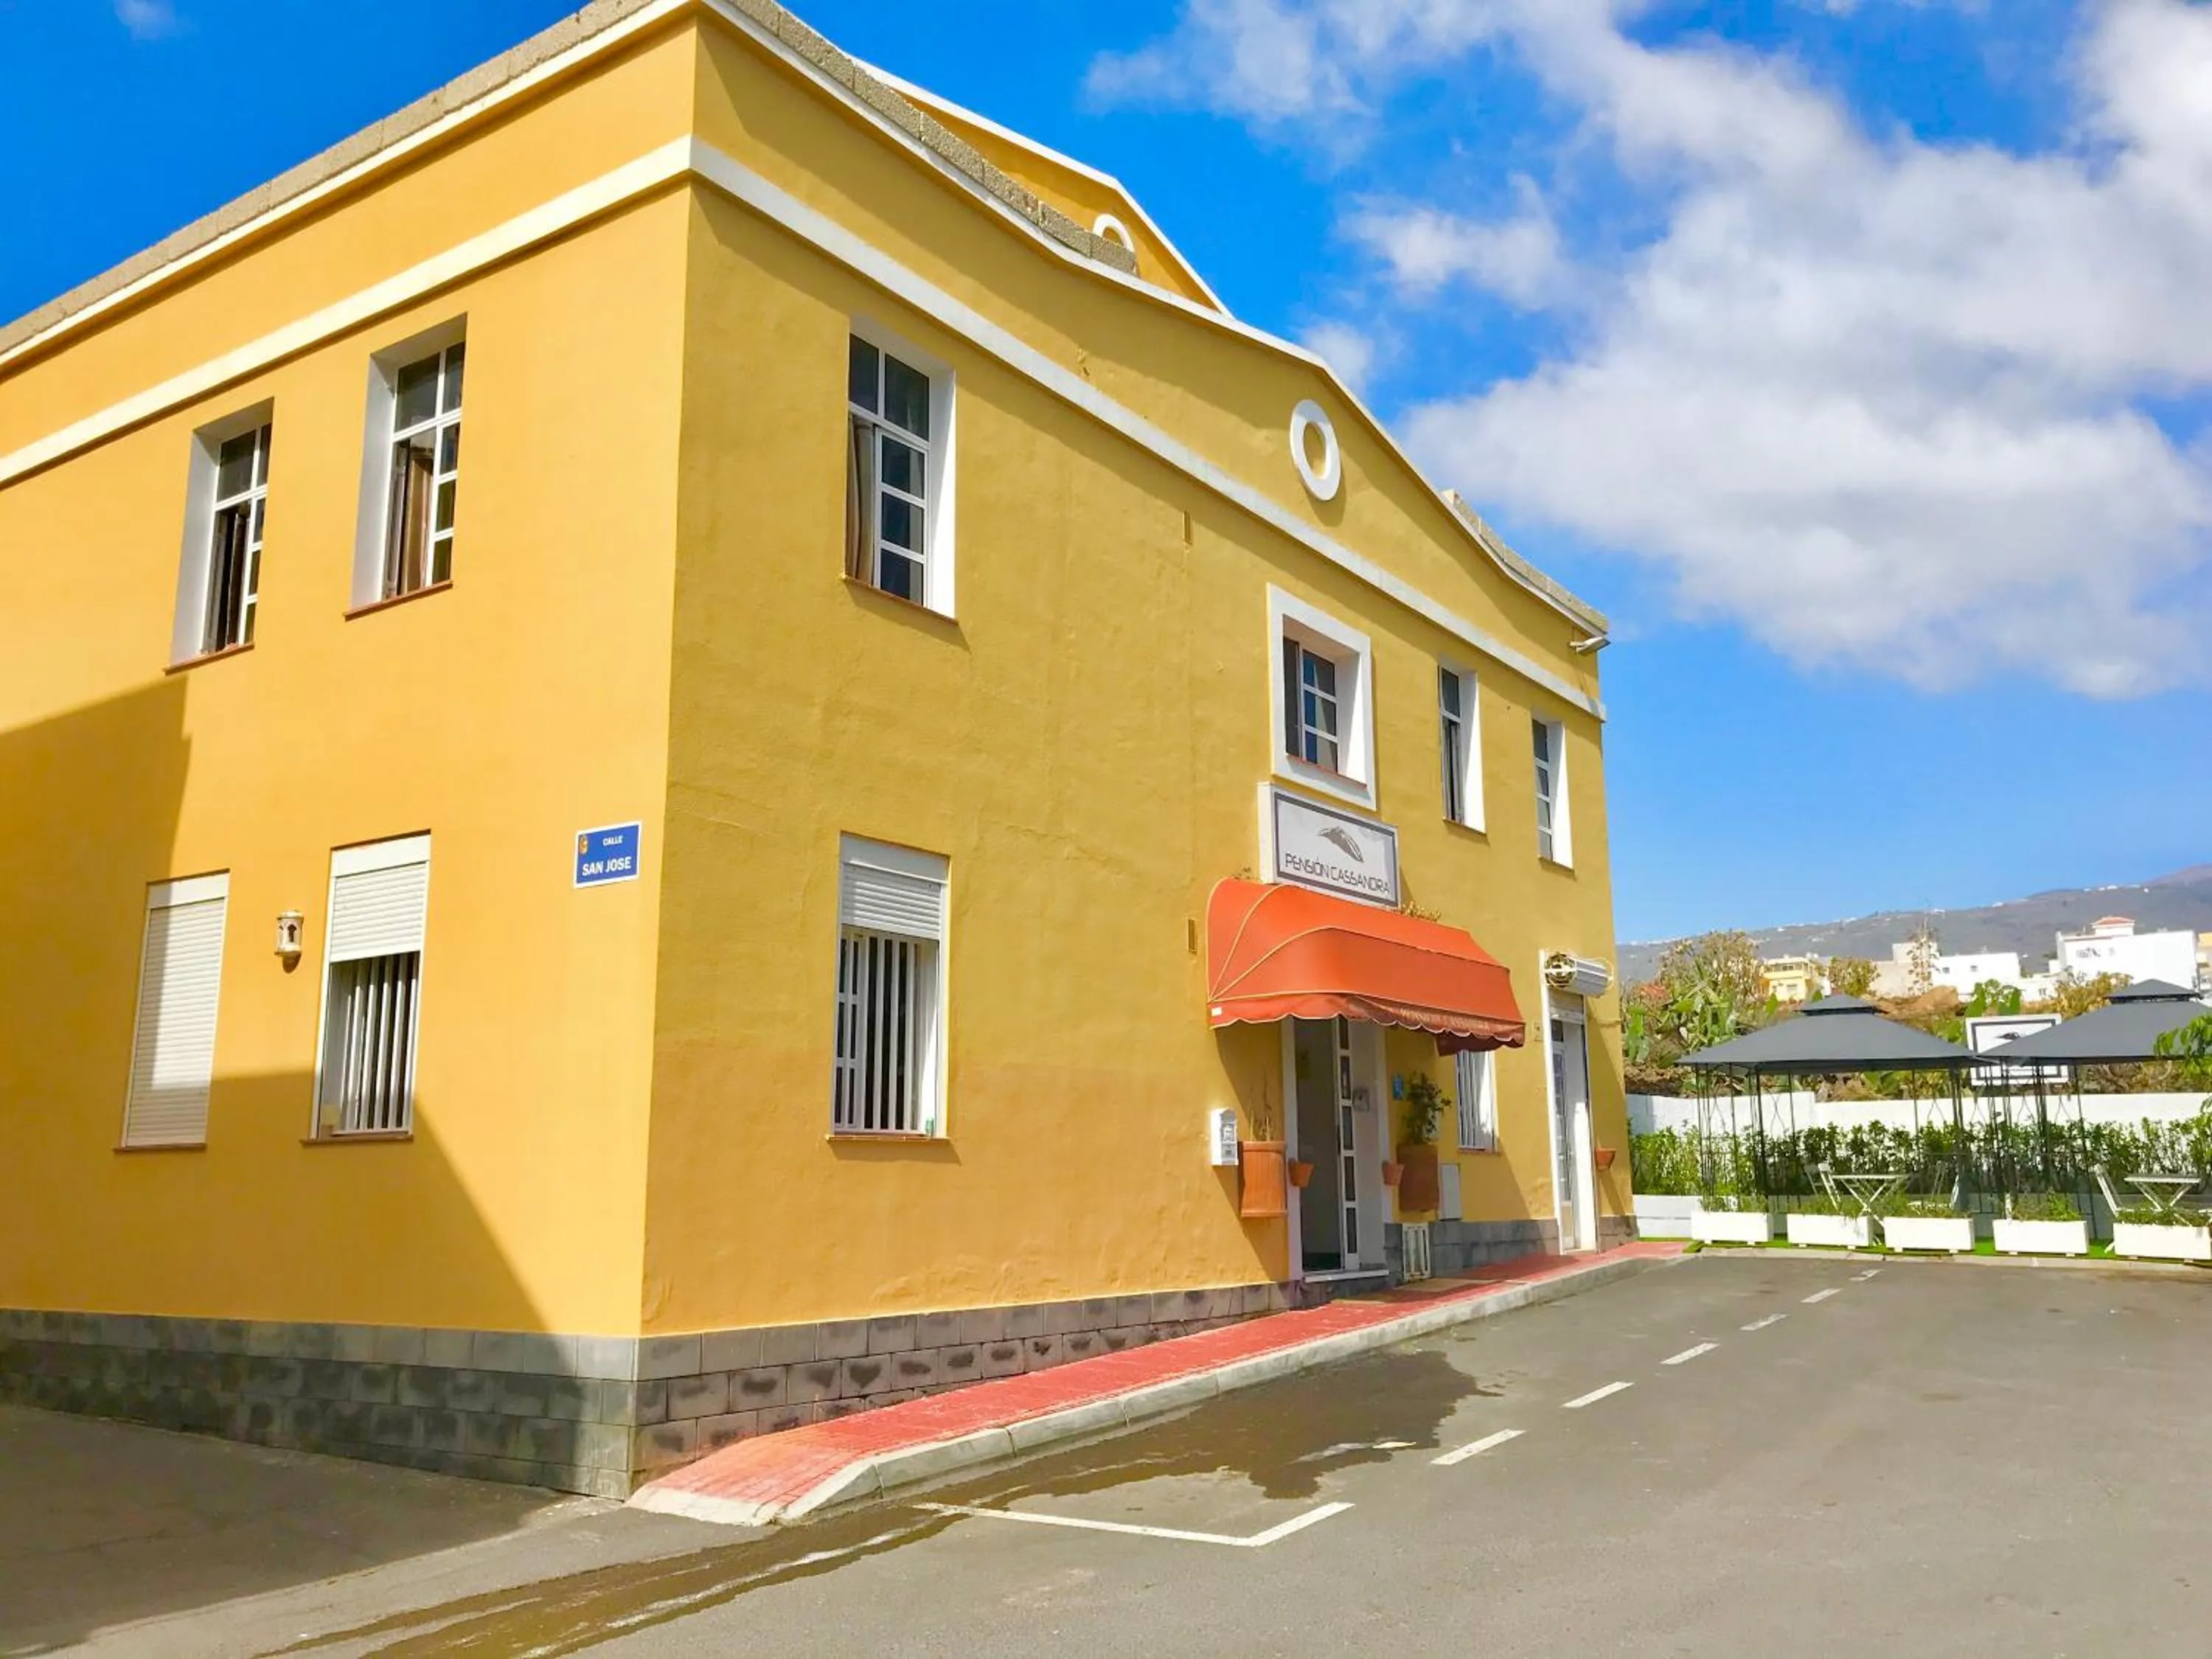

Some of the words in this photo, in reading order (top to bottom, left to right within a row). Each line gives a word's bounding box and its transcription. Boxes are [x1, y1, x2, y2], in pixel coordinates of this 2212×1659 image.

[602, 835, 623, 846] CALLE
[582, 860, 603, 876] SAN
[605, 856, 632, 872] JOSE
[1332, 866, 1390, 894] CASSANDRA
